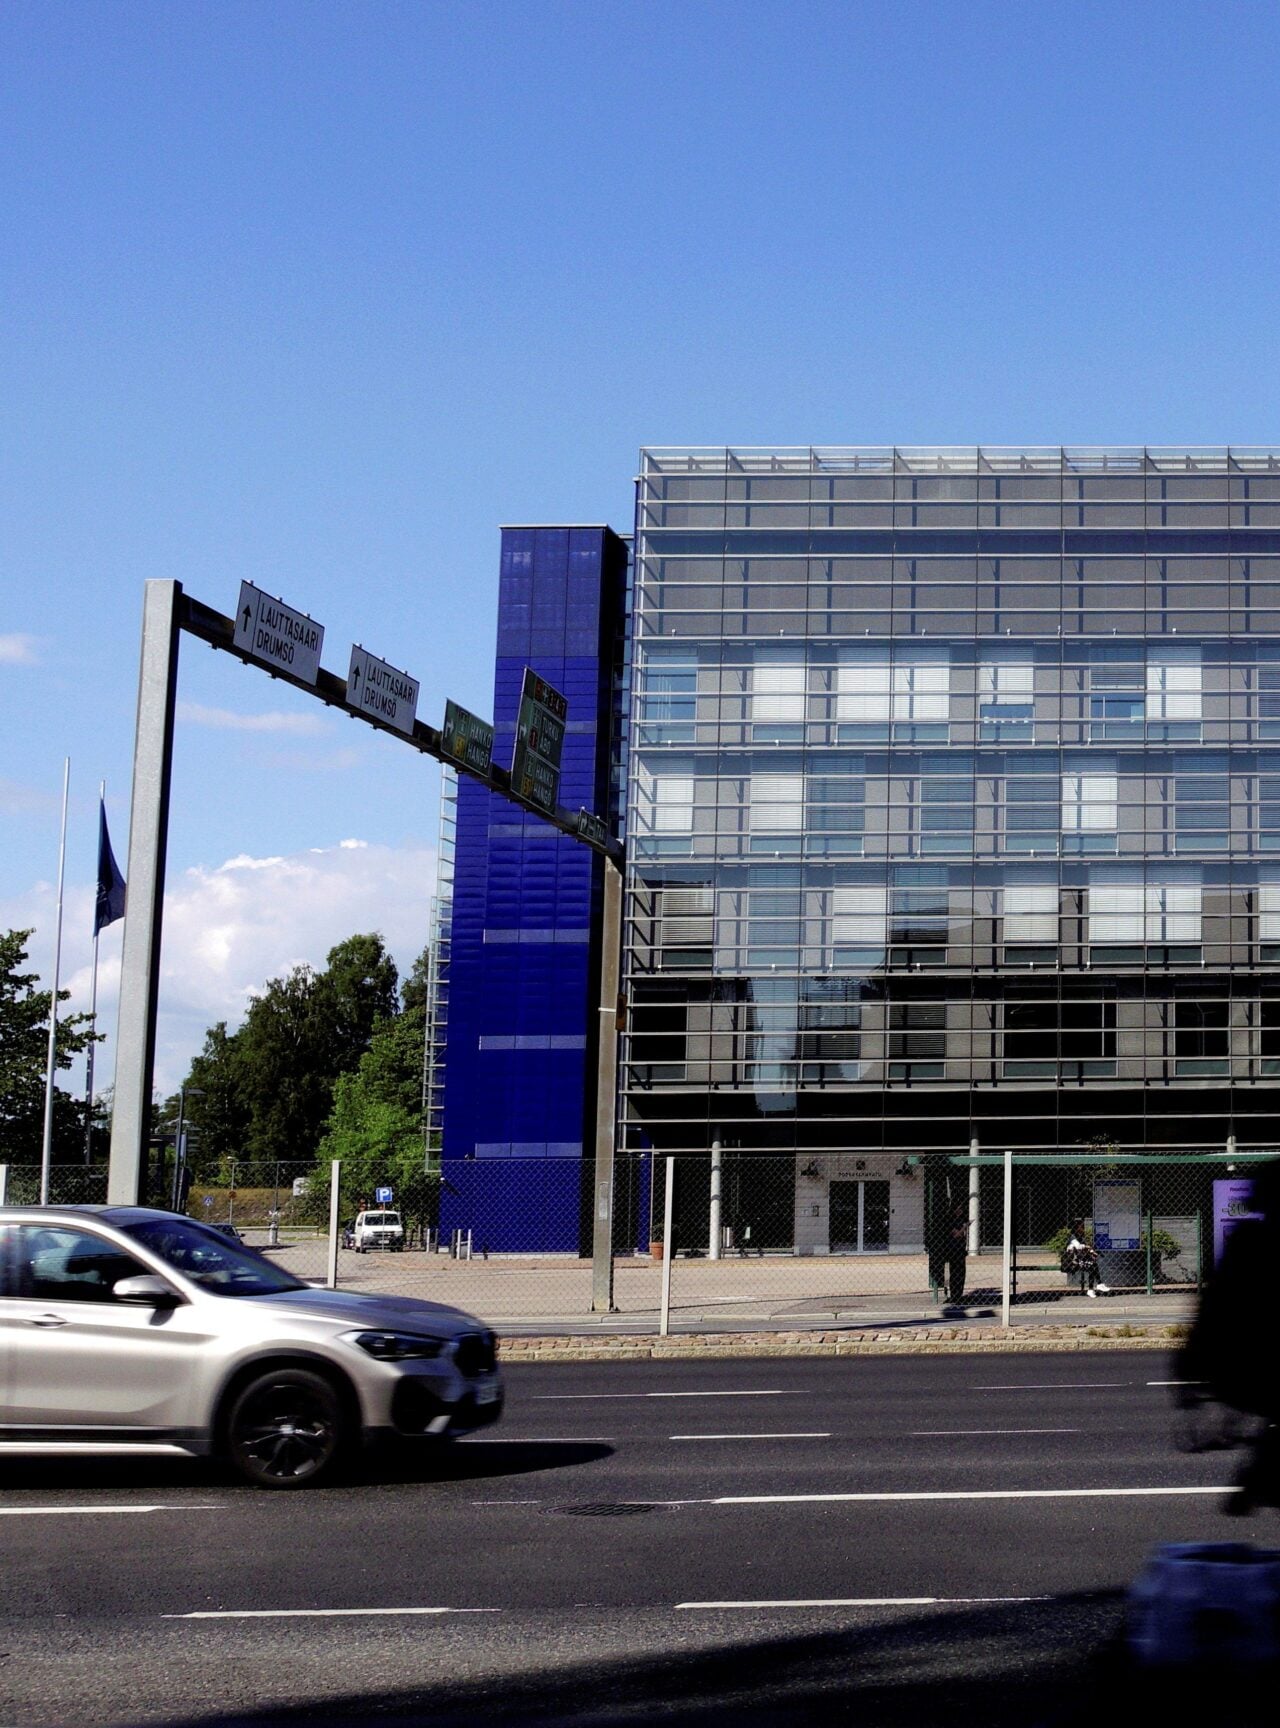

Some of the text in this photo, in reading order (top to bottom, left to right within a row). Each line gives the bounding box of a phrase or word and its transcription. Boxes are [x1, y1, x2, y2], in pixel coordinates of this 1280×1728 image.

[256, 628, 295, 665] DRUMSÖ
[260, 603, 319, 652] LAUTTASAARI
[364, 687, 397, 719] DRUMSÖ
[367, 663, 415, 705] LAUTTASAARI
